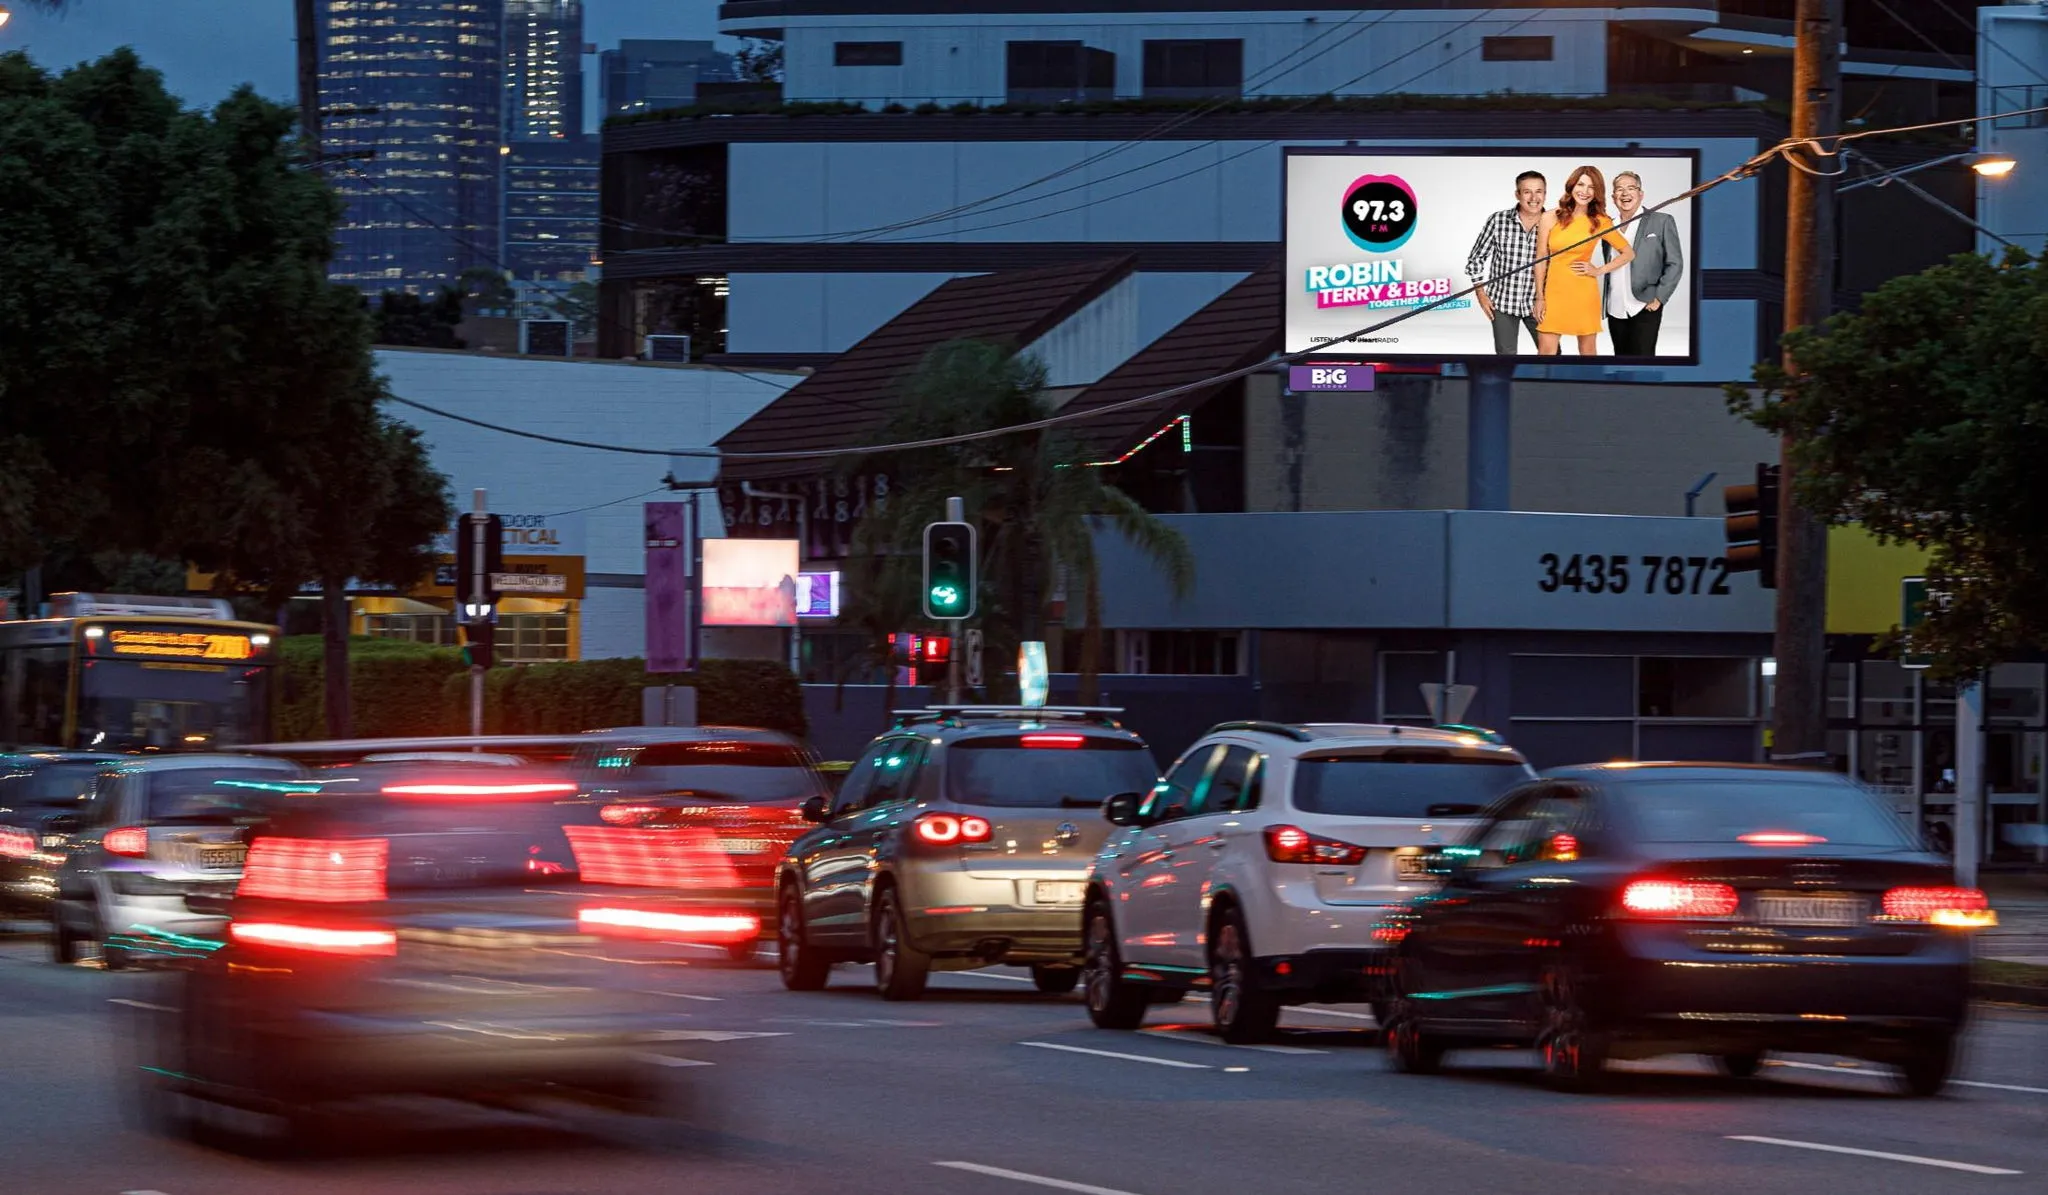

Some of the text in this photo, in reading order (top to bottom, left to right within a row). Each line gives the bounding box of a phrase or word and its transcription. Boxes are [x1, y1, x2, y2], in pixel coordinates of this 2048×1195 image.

[1353, 200, 1405, 222] 97.3
[1309, 259, 1403, 289] ROBIN
[1319, 277, 1449, 304] TERRY & BOB
[1370, 297, 1419, 308] TOGETHER
[1311, 368, 1347, 385] BiG
[1538, 553, 1731, 595] 3435 7872
